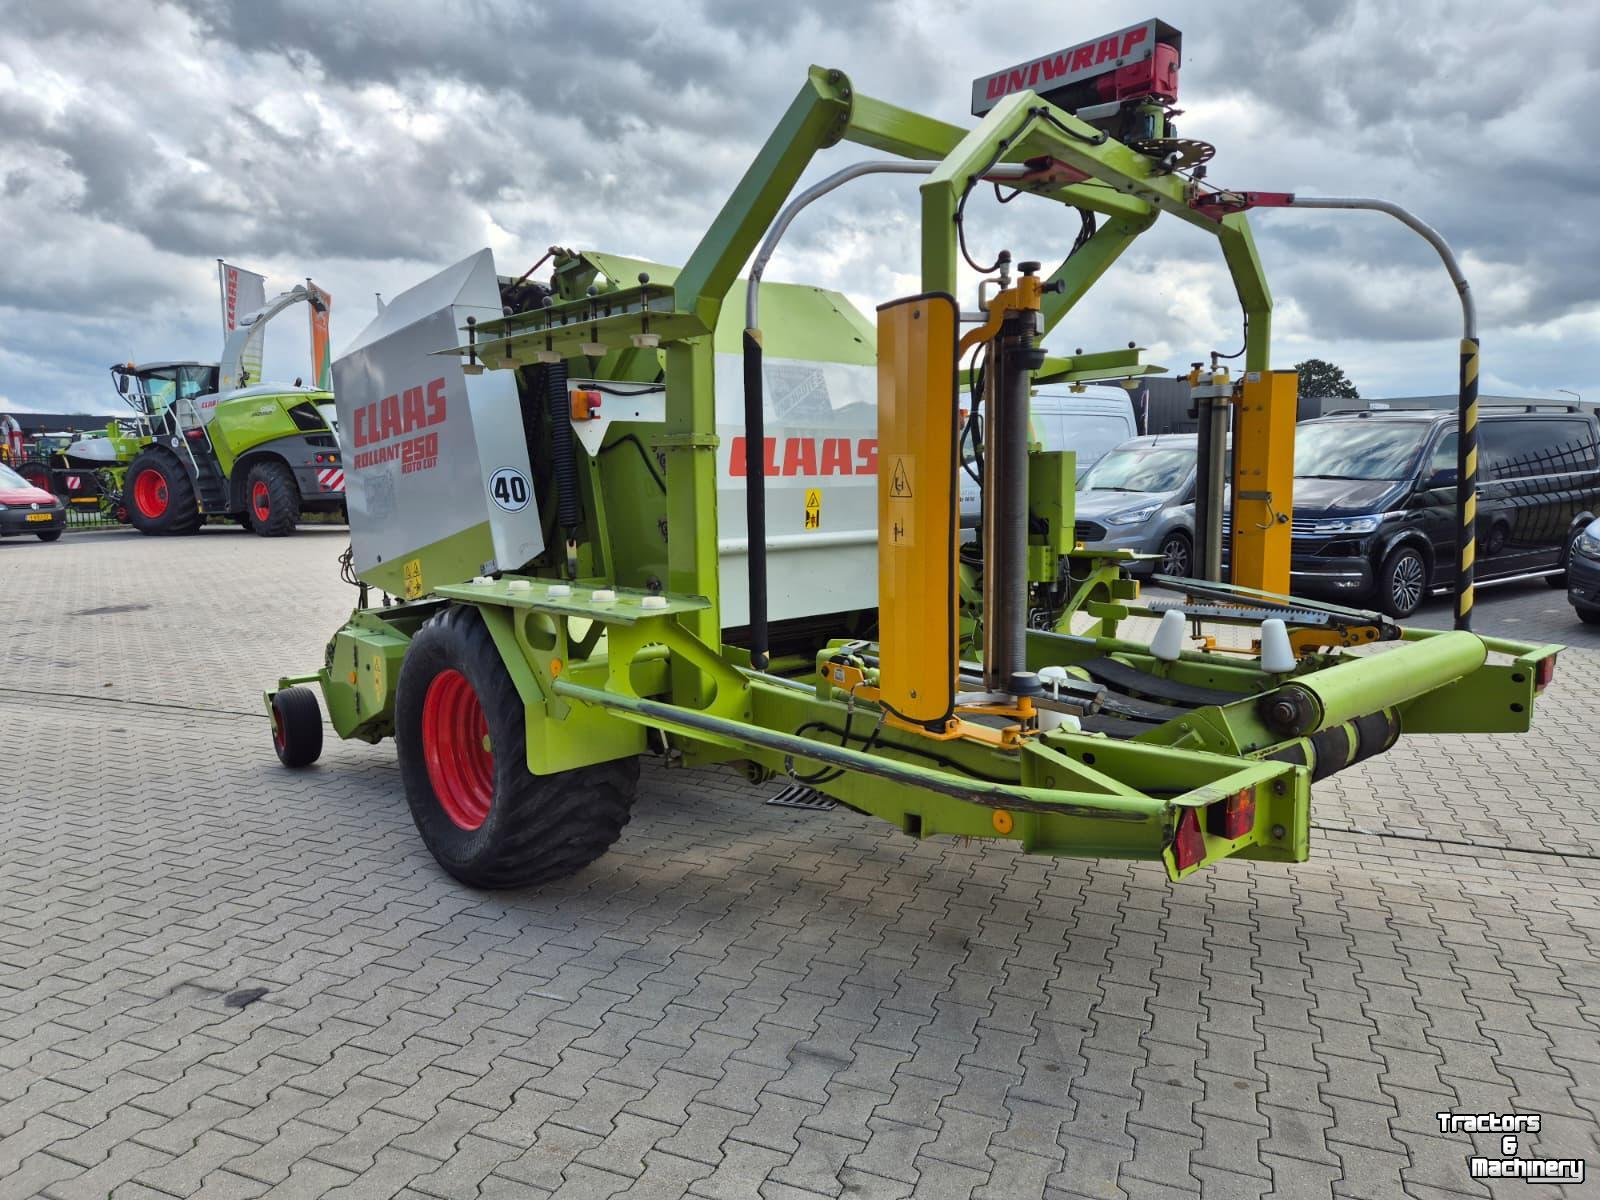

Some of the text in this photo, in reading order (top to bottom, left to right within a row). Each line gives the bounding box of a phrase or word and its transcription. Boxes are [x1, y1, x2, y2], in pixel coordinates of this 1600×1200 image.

[986, 27, 1148, 99] UNIWRAP
[354, 377, 447, 448] CLAAS
[354, 432, 438, 470] ROLLANT 250
[402, 457, 437, 474] ROTO CUT
[494, 476, 526, 504] 40
